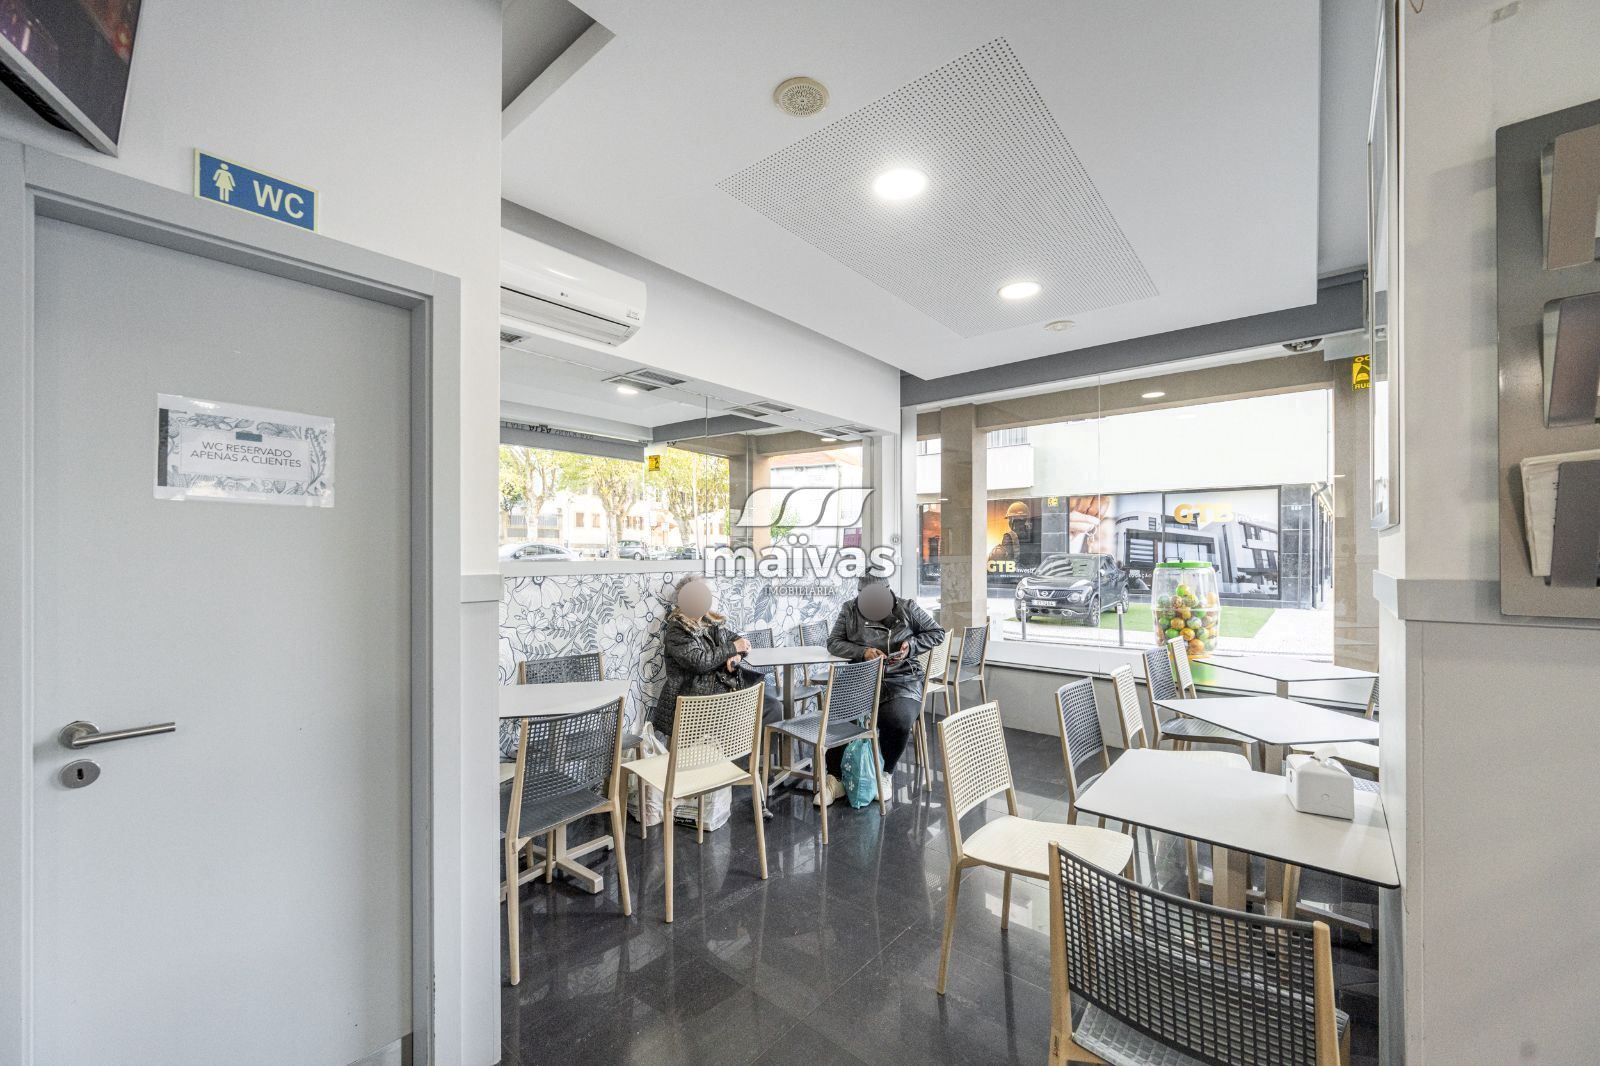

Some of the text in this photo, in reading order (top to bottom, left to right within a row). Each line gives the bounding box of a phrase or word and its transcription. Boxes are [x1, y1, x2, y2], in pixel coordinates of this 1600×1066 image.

[252, 179, 304, 219] WC
[202, 441, 292, 458] WC RESERVADO
[190, 450, 239, 462] APENAS
[251, 455, 302, 468] CLIENTES
[1174, 502, 1233, 524] GTB
[987, 559, 1016, 573] GTB
